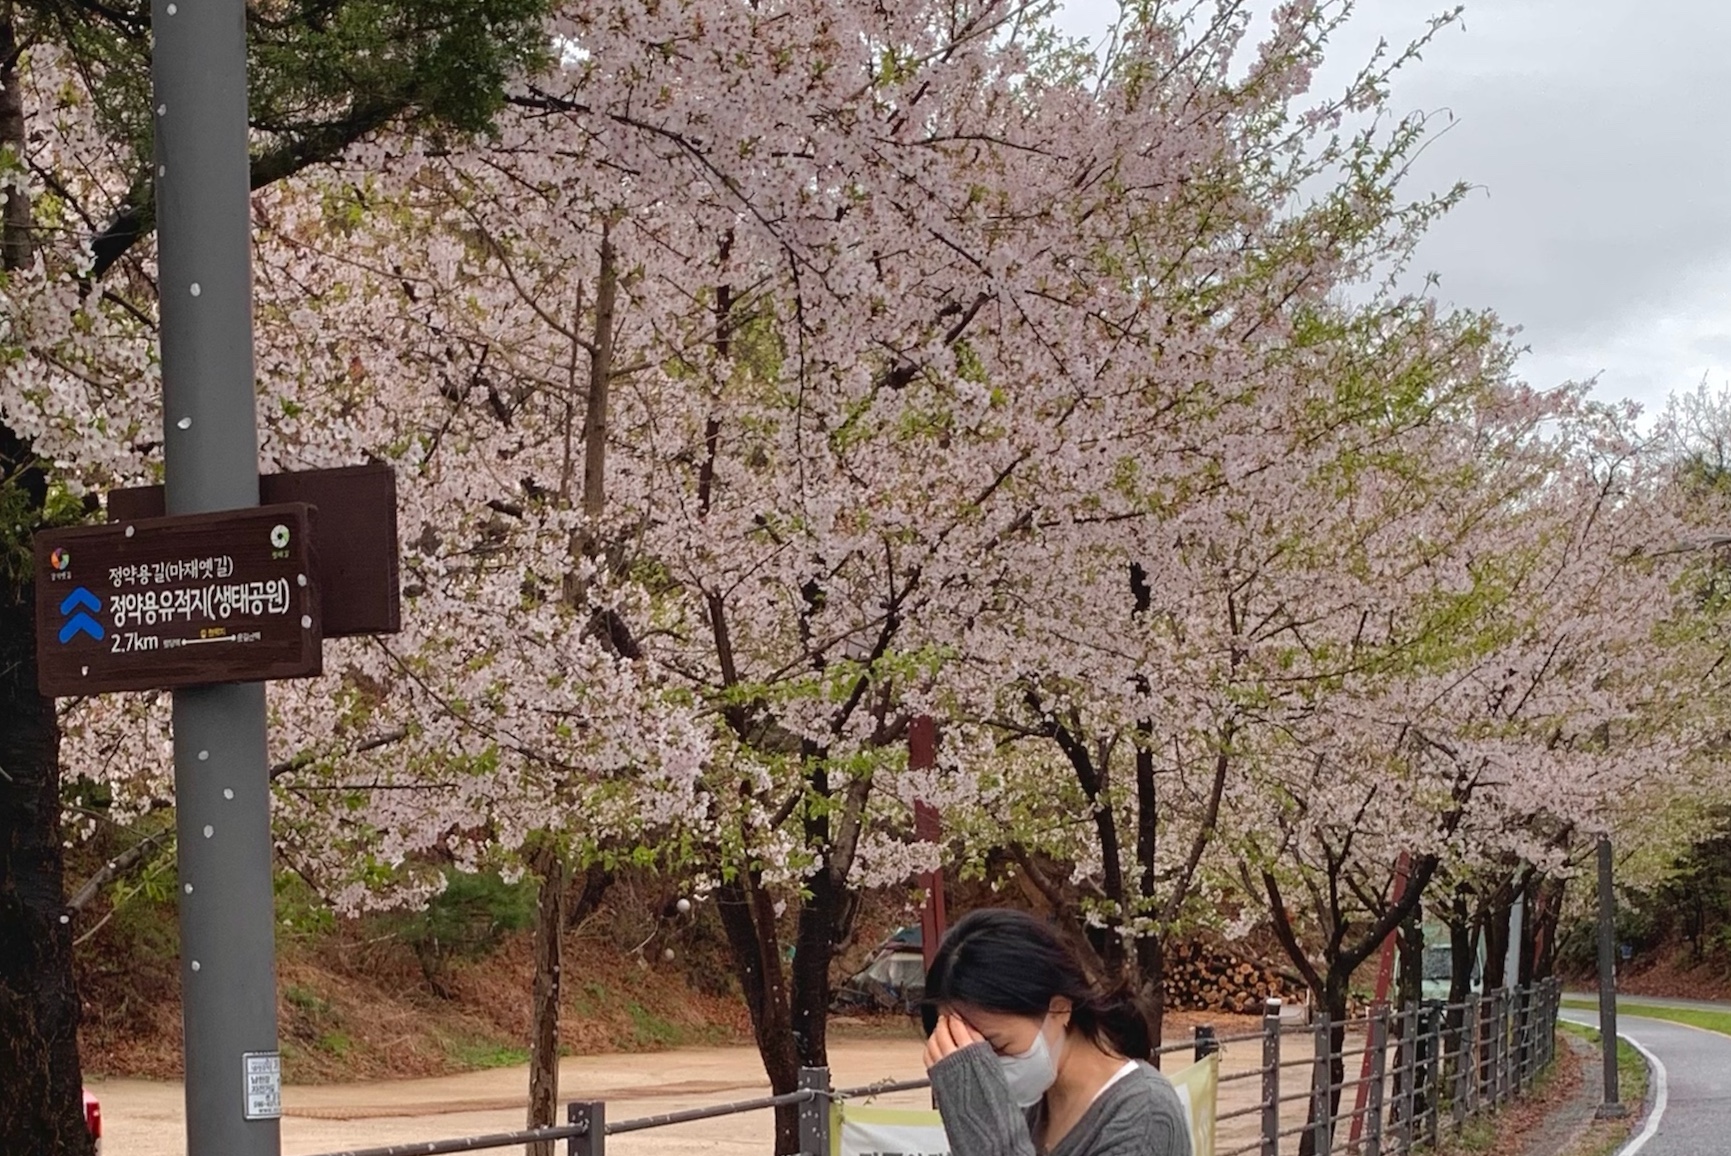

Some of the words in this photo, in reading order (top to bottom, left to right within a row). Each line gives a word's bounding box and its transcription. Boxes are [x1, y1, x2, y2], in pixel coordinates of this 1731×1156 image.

[108, 555, 234, 588] 정약용길(마재옛길)
[109, 577, 290, 628] 정약용유적지(생태공원)
[110, 631, 159, 654] 2.7km
